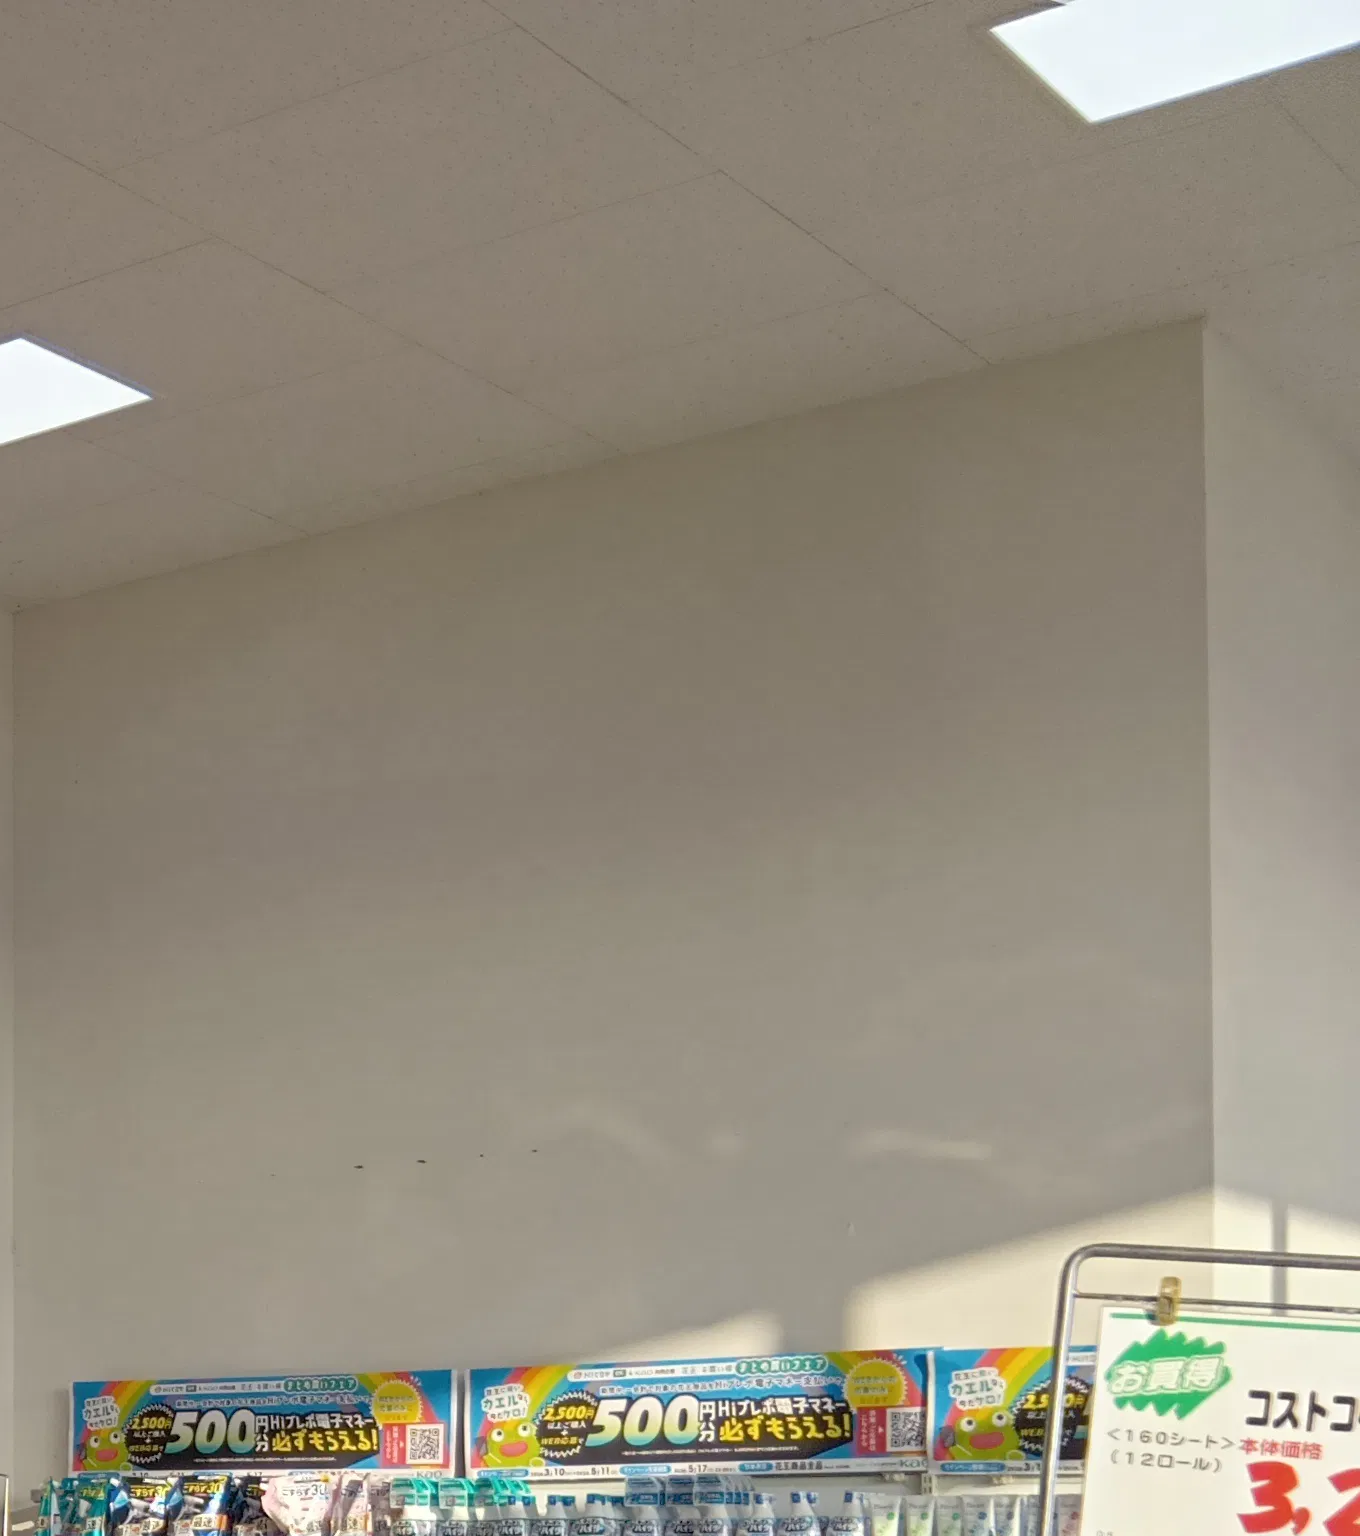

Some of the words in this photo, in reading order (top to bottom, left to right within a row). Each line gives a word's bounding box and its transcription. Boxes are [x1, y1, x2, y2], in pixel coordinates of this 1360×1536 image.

[1108, 1352, 1228, 1399] お買得
[1245, 1389, 1360, 1433] コストコ
[271, 1427, 378, 1453] 必ずもらえる!
[718, 1412, 852, 1443] 必ずもらえる!
[1238, 1436, 1324, 1462] 本体価格
